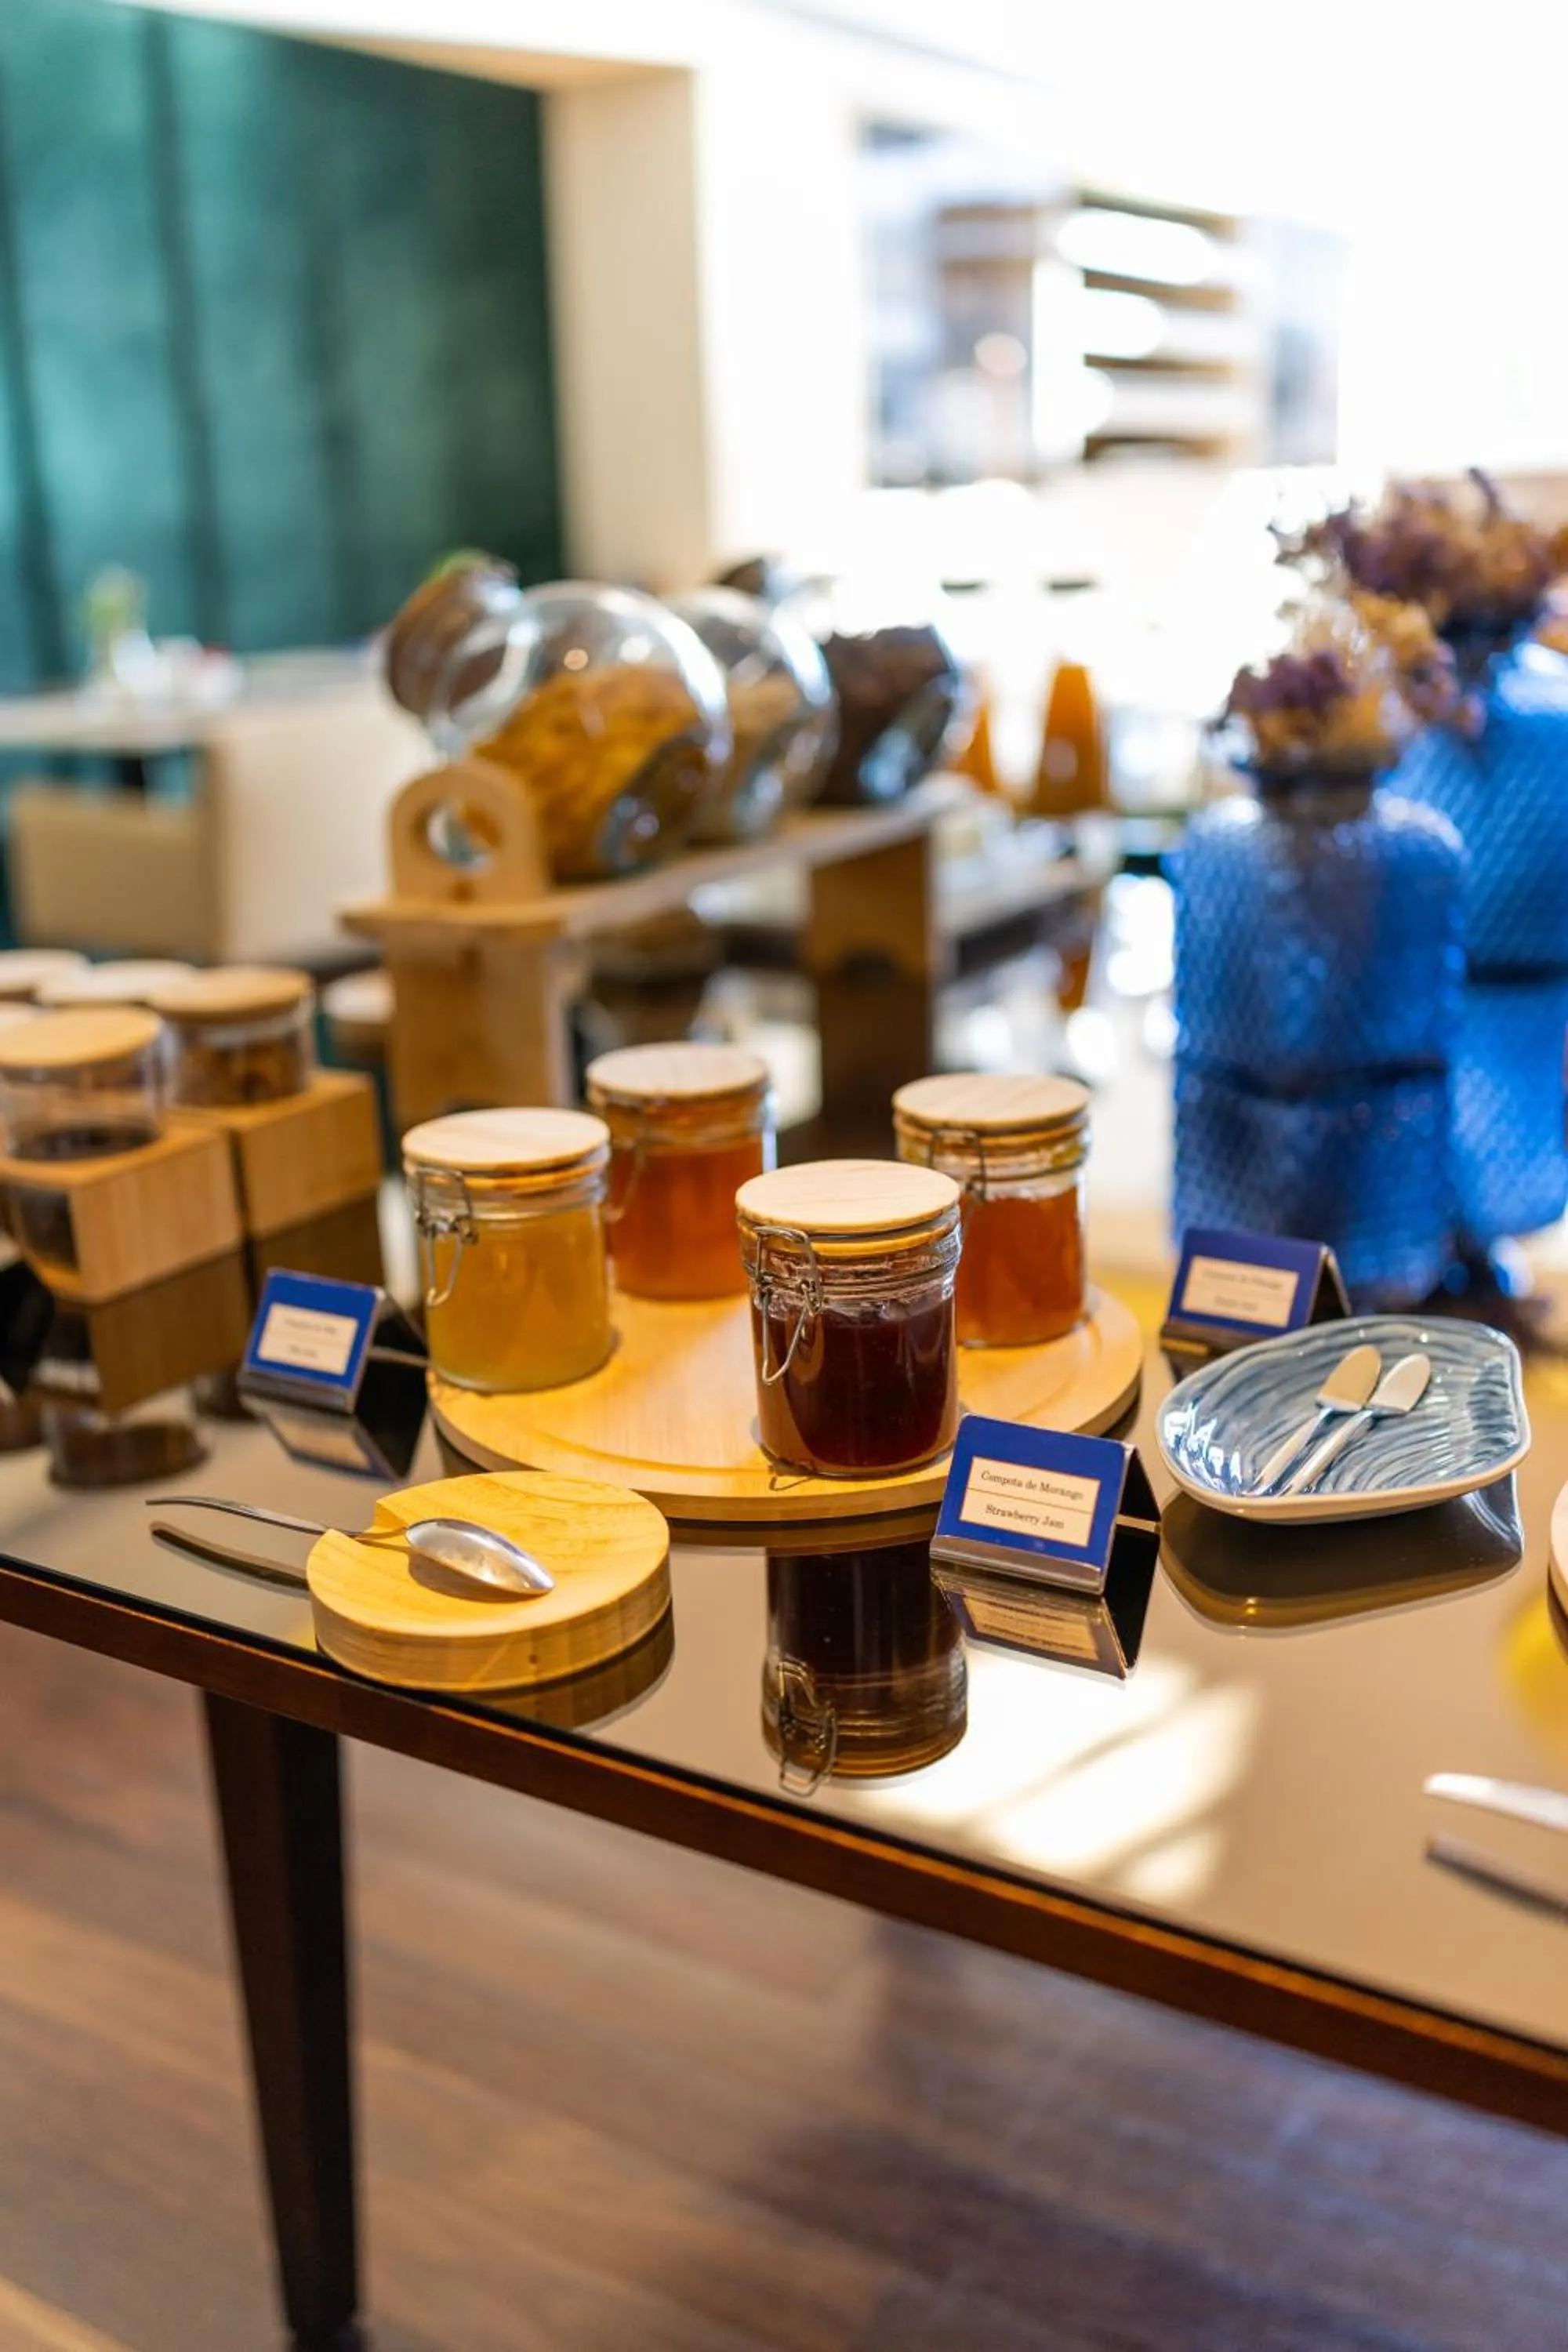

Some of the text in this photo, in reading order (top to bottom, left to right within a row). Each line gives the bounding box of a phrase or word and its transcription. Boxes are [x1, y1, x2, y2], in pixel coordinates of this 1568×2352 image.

[981, 1470, 1083, 1500] Compota de Morango
[985, 1504, 1065, 1529] Strawberry Jam
